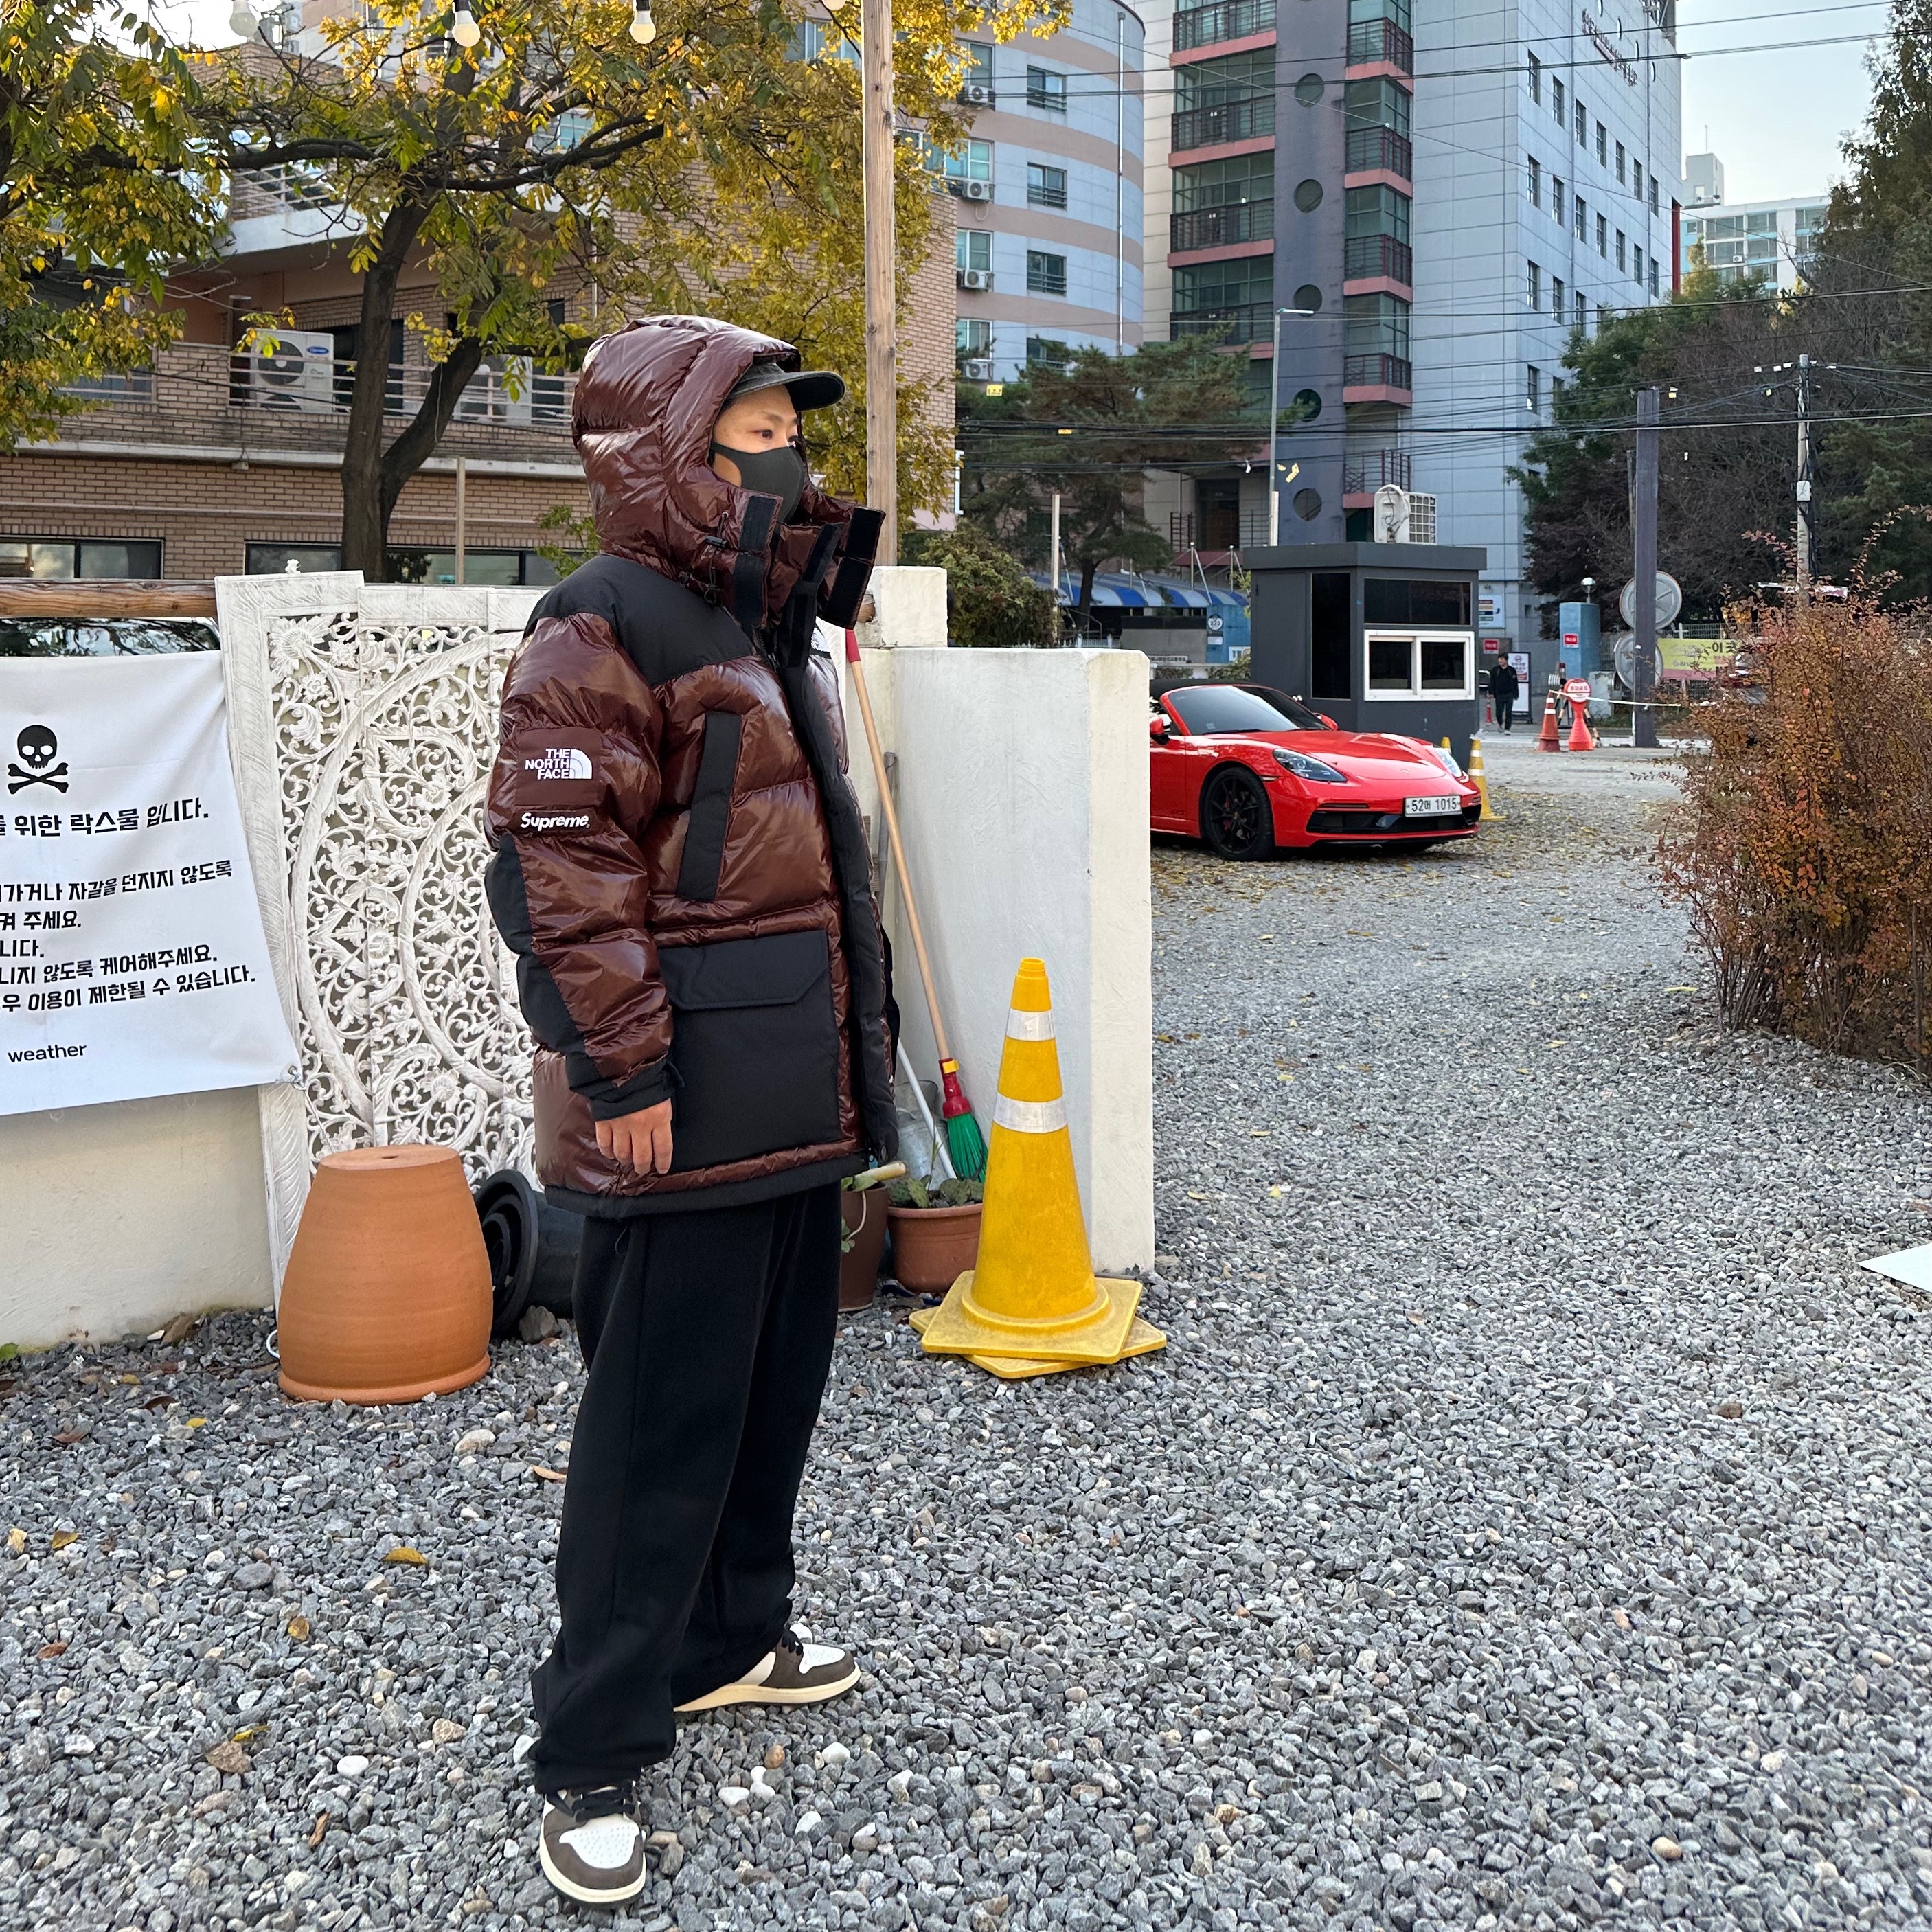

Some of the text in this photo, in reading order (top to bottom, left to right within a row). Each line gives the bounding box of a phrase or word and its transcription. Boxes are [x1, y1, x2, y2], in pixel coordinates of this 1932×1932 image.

[545, 748, 571, 759] THE
[525, 758, 569, 770] NORTH
[537, 769, 569, 780] FACE
[1435, 797, 1457, 810] 1015
[14, 815, 62, 837] 위한
[70, 808, 139, 835] 락스물
[146, 797, 209, 828] 입니다.
[520, 812, 590, 832] Supreme
[68, 878, 117, 901] 자갈을
[122, 870, 174, 894] 던지지
[180, 860, 232, 885] 않도록
[23, 910, 82, 930] 주세요.
[43, 959, 94, 984] 않도록
[100, 944, 218, 976] 케어해주세요.
[28, 988, 82, 1011] 이용이
[88, 981, 146, 1005] 제한될
[152, 977, 170, 996] 수
[176, 964, 256, 992] 있습니다.
[8, 1044, 87, 1062] weather
